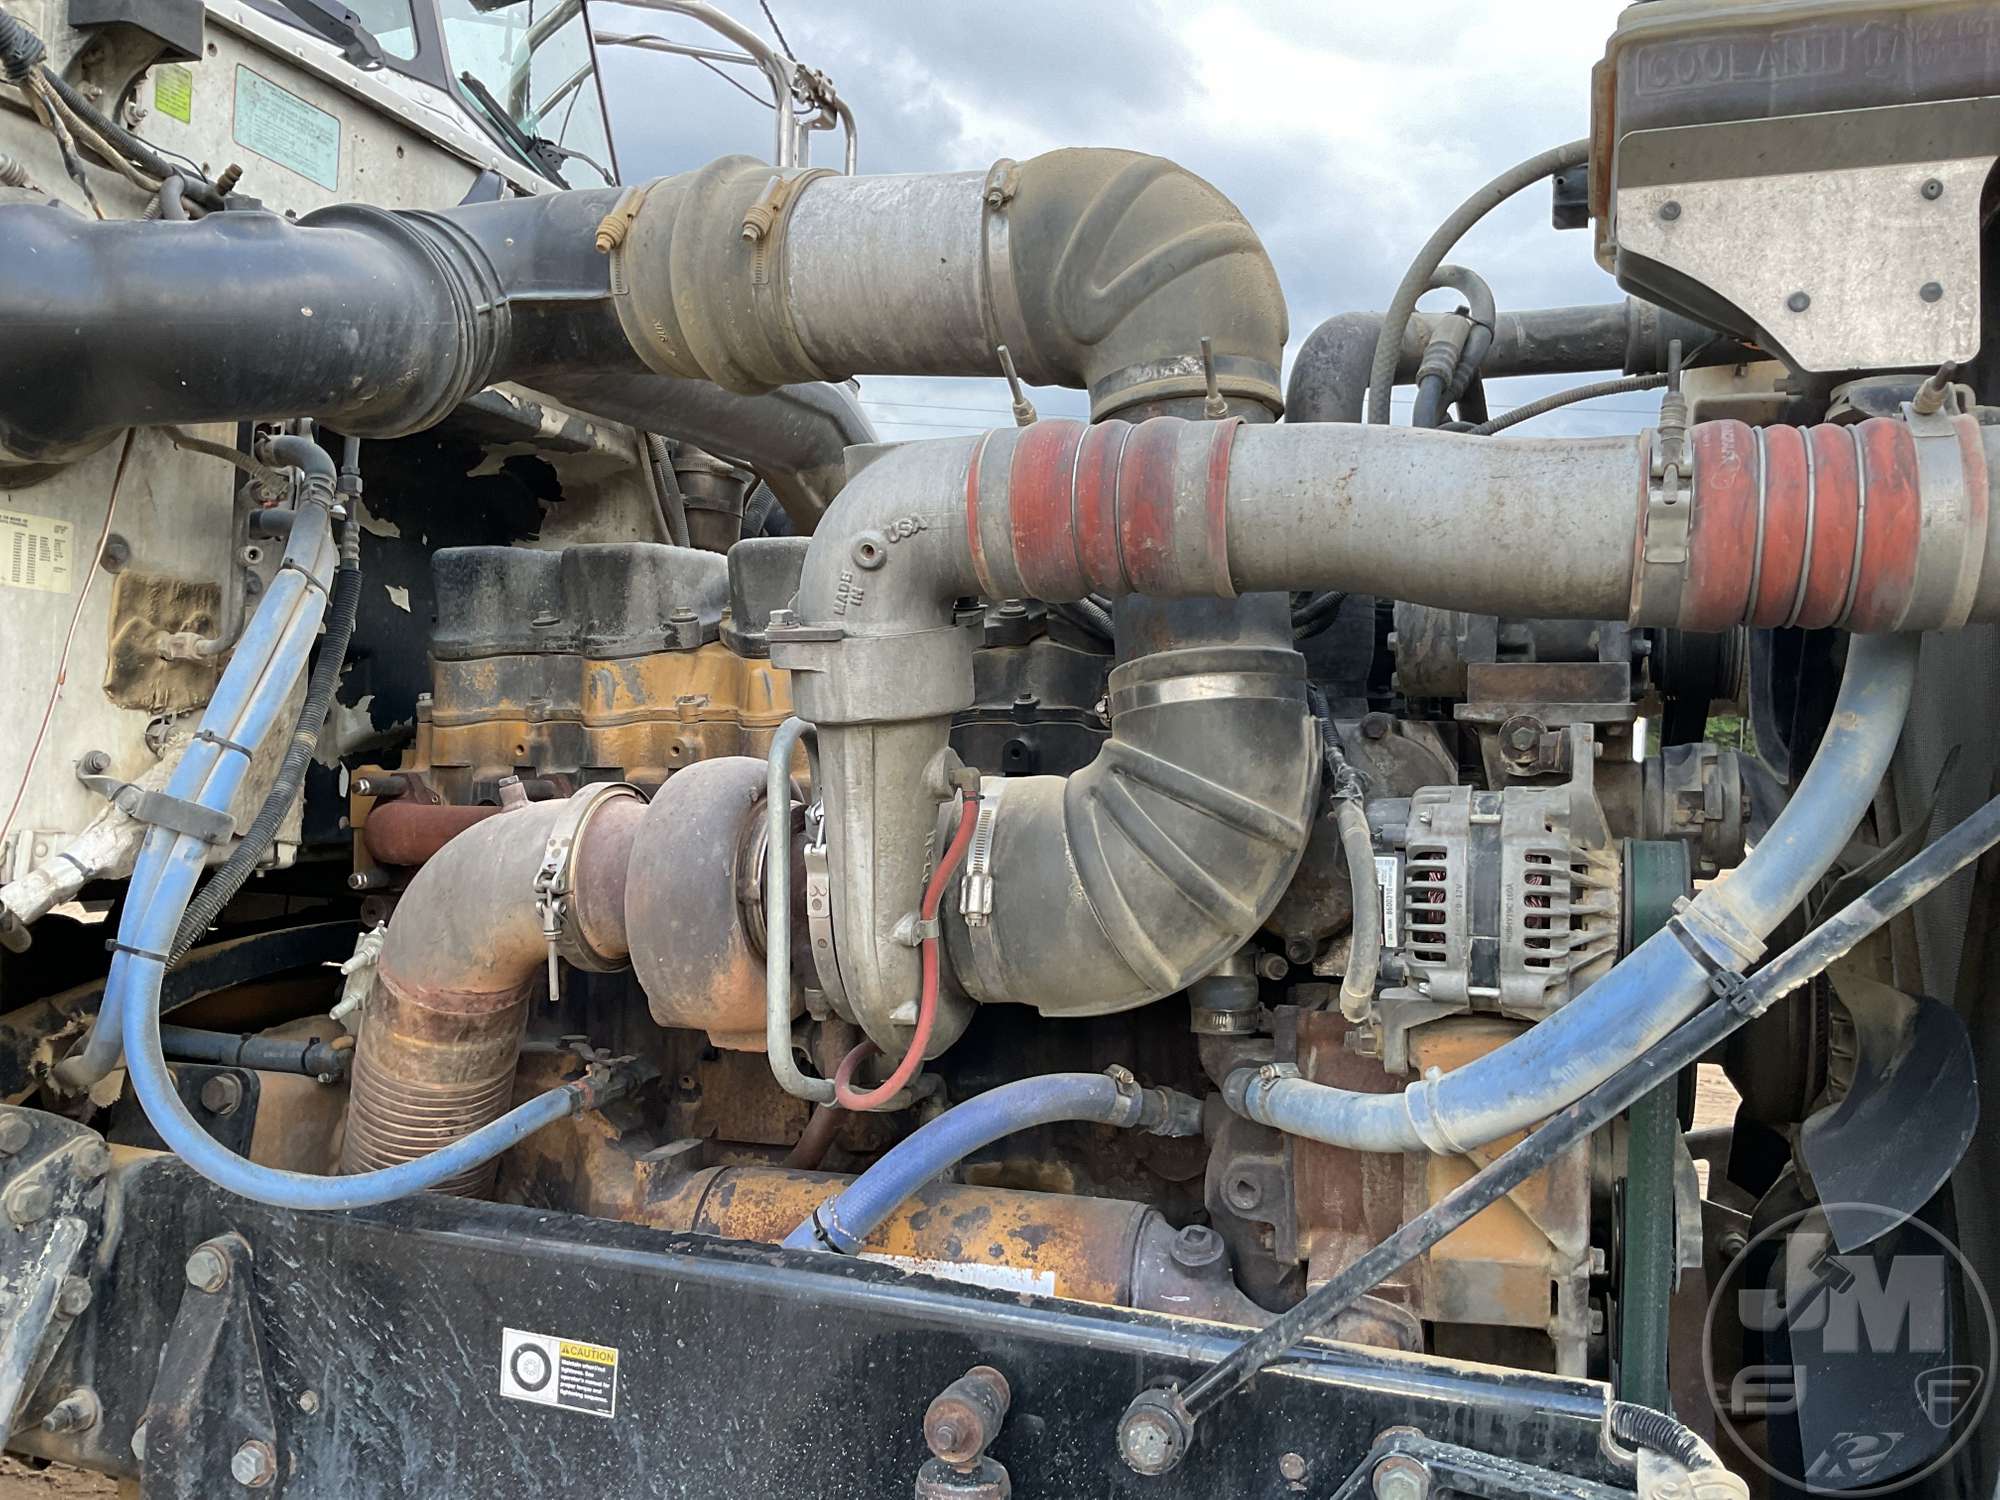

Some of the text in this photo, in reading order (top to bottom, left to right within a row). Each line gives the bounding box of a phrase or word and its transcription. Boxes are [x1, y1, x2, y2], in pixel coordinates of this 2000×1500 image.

[1649, 32, 1834, 88] COOLANT
[885, 512, 927, 544] USA
[833, 569, 853, 616] MADE
[849, 586, 865, 607] IN
[570, 1345, 614, 1363] CAUTION
